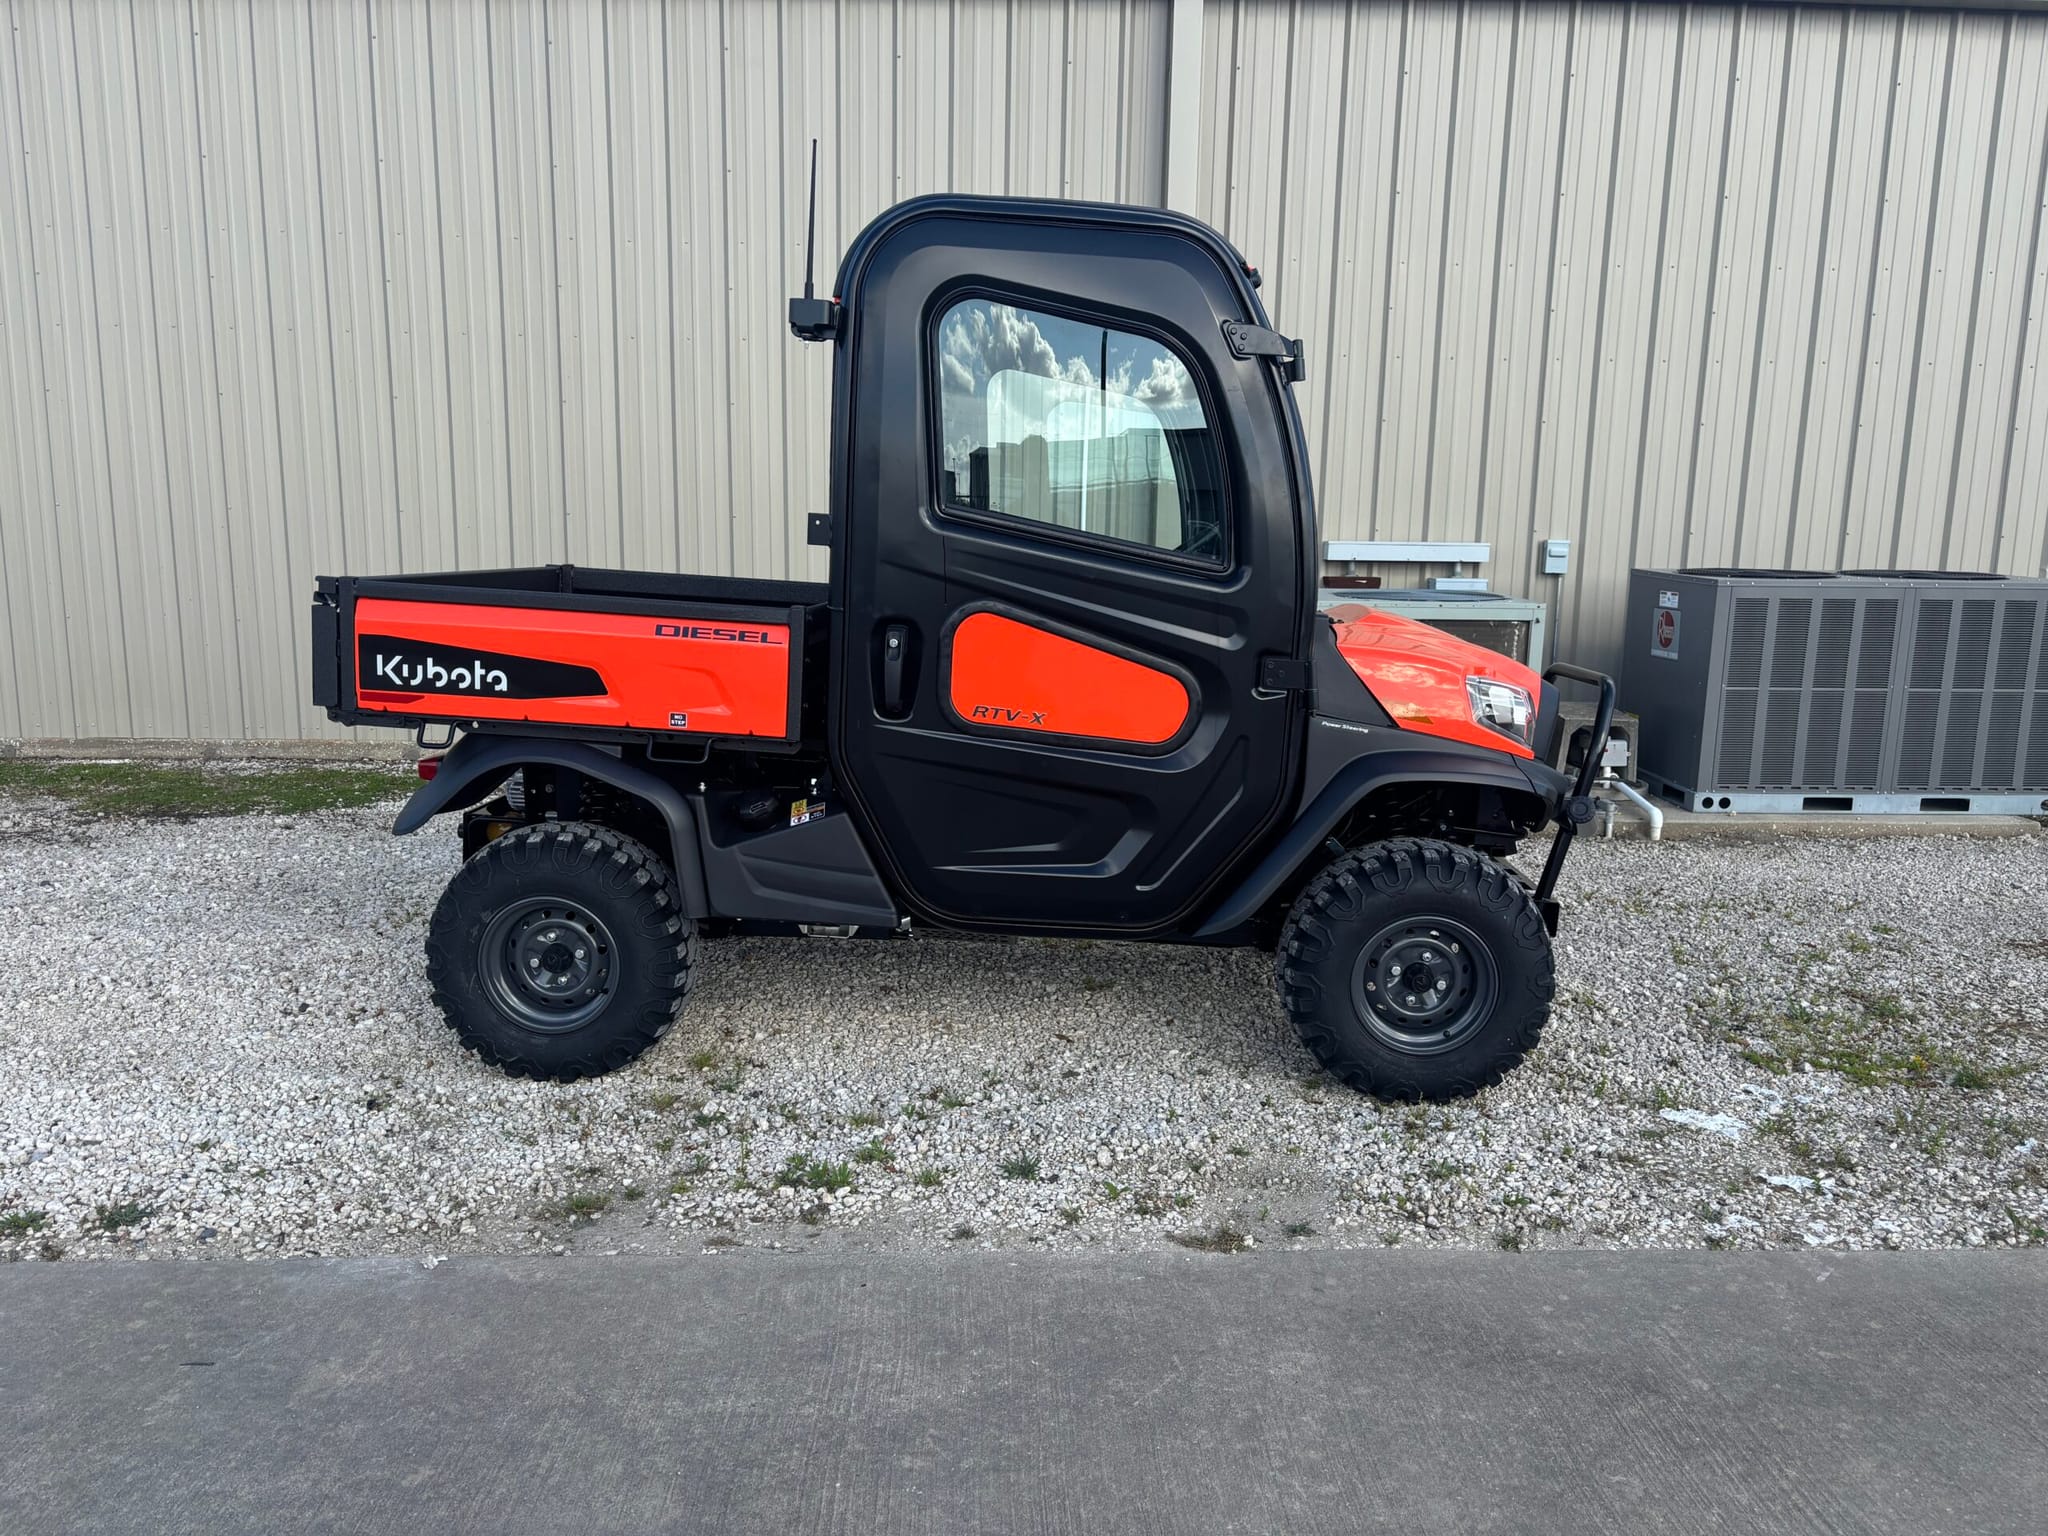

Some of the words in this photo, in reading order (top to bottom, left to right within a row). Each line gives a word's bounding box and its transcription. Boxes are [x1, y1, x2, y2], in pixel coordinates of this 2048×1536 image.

[655, 624, 783, 644] DIESEL
[376, 654, 508, 691] Kubota
[973, 706, 1046, 726] RTV-X
